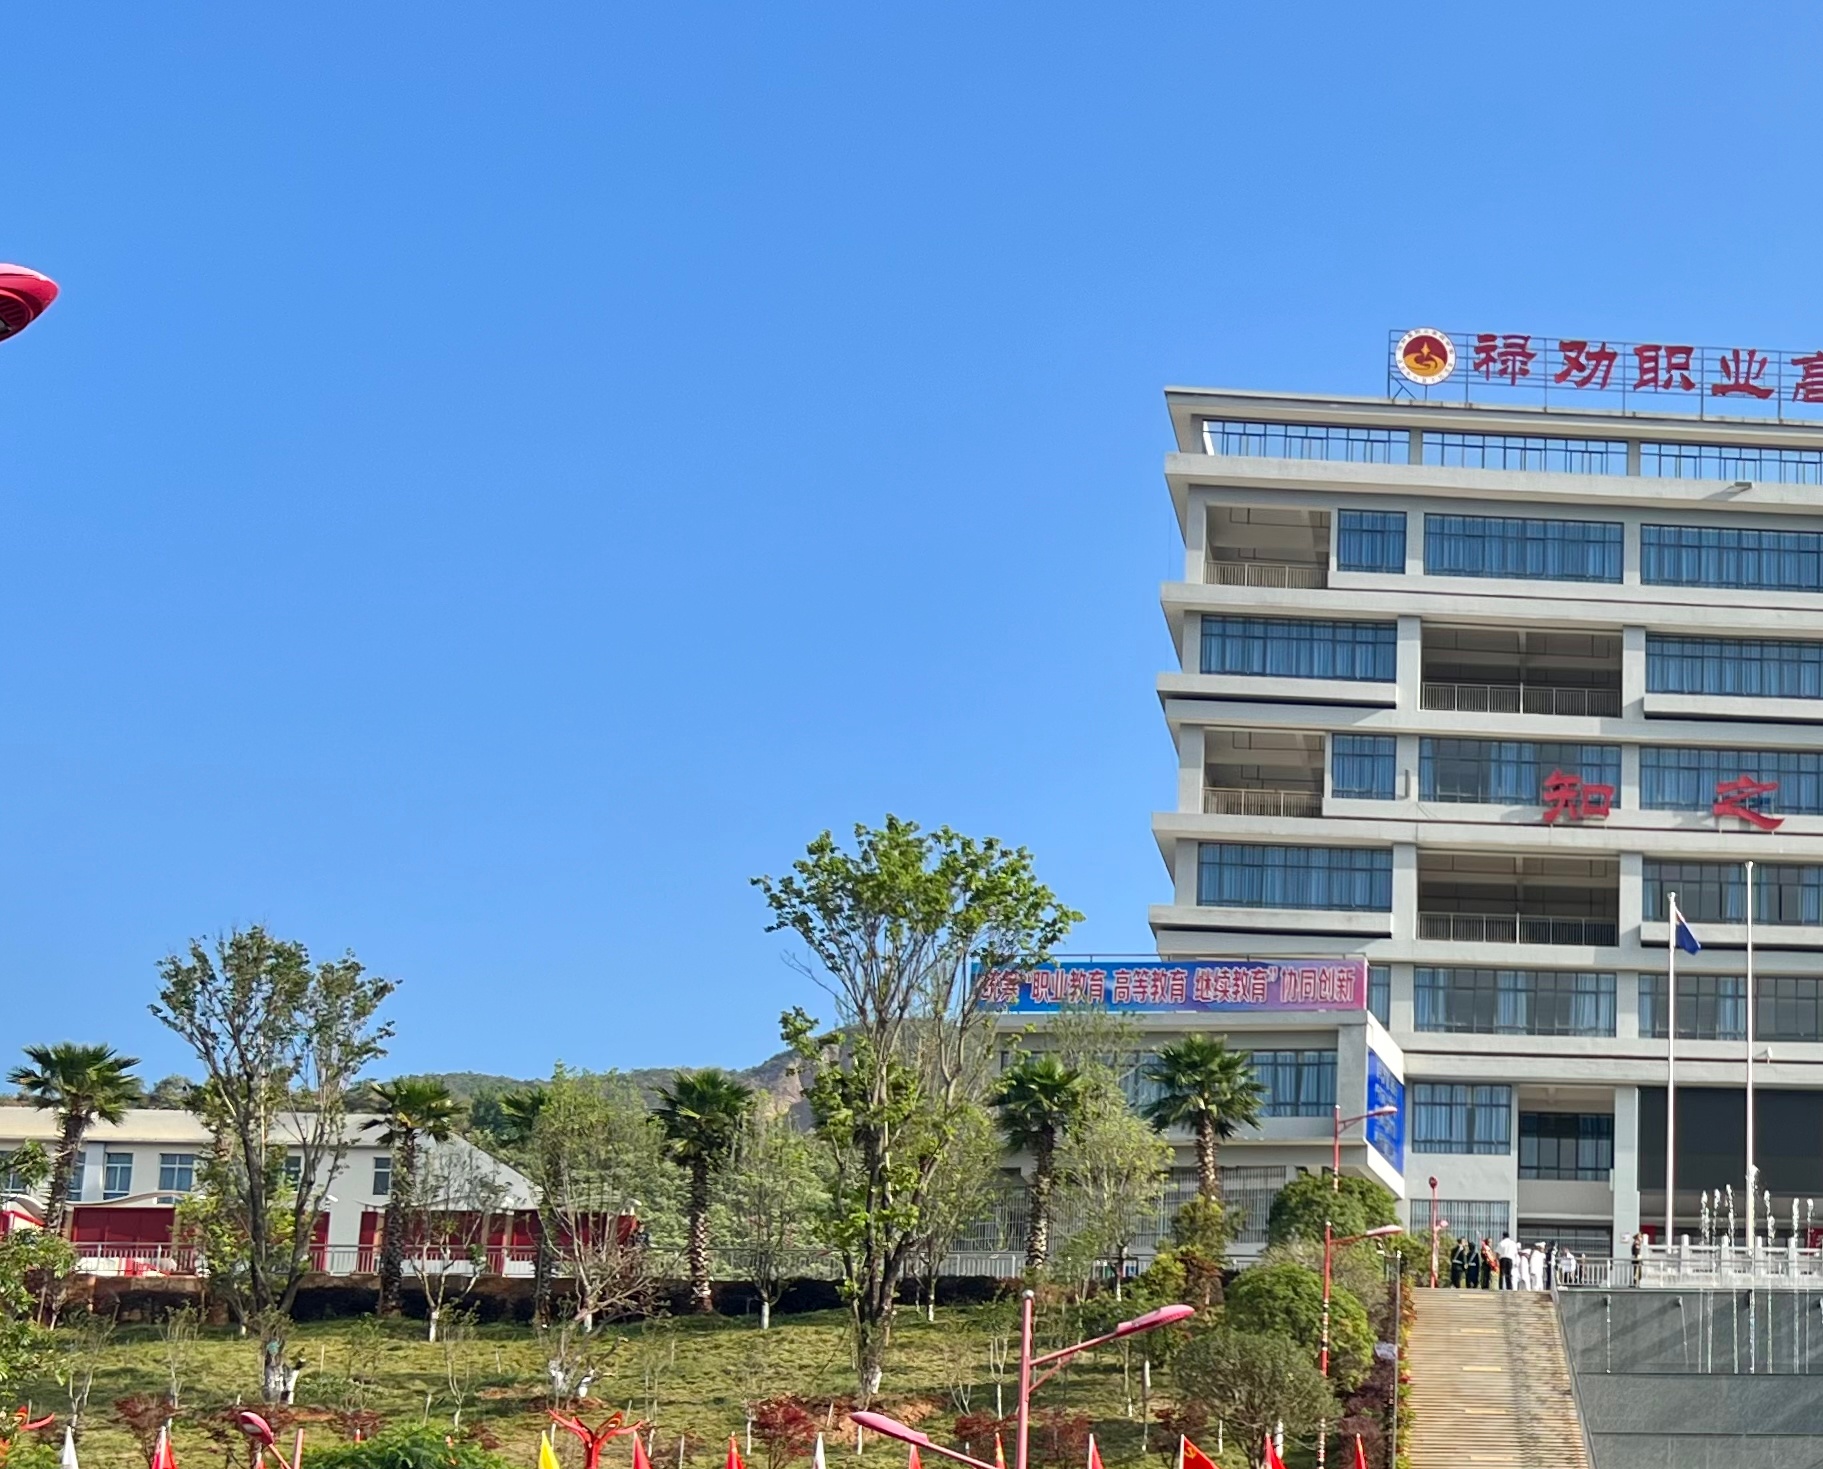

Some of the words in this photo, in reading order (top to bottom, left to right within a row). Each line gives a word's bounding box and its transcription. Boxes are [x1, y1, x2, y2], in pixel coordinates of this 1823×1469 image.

[1113, 967, 1188, 1004] 高等教育
[1193, 964, 1356, 1003] 继续教育”协同创新
